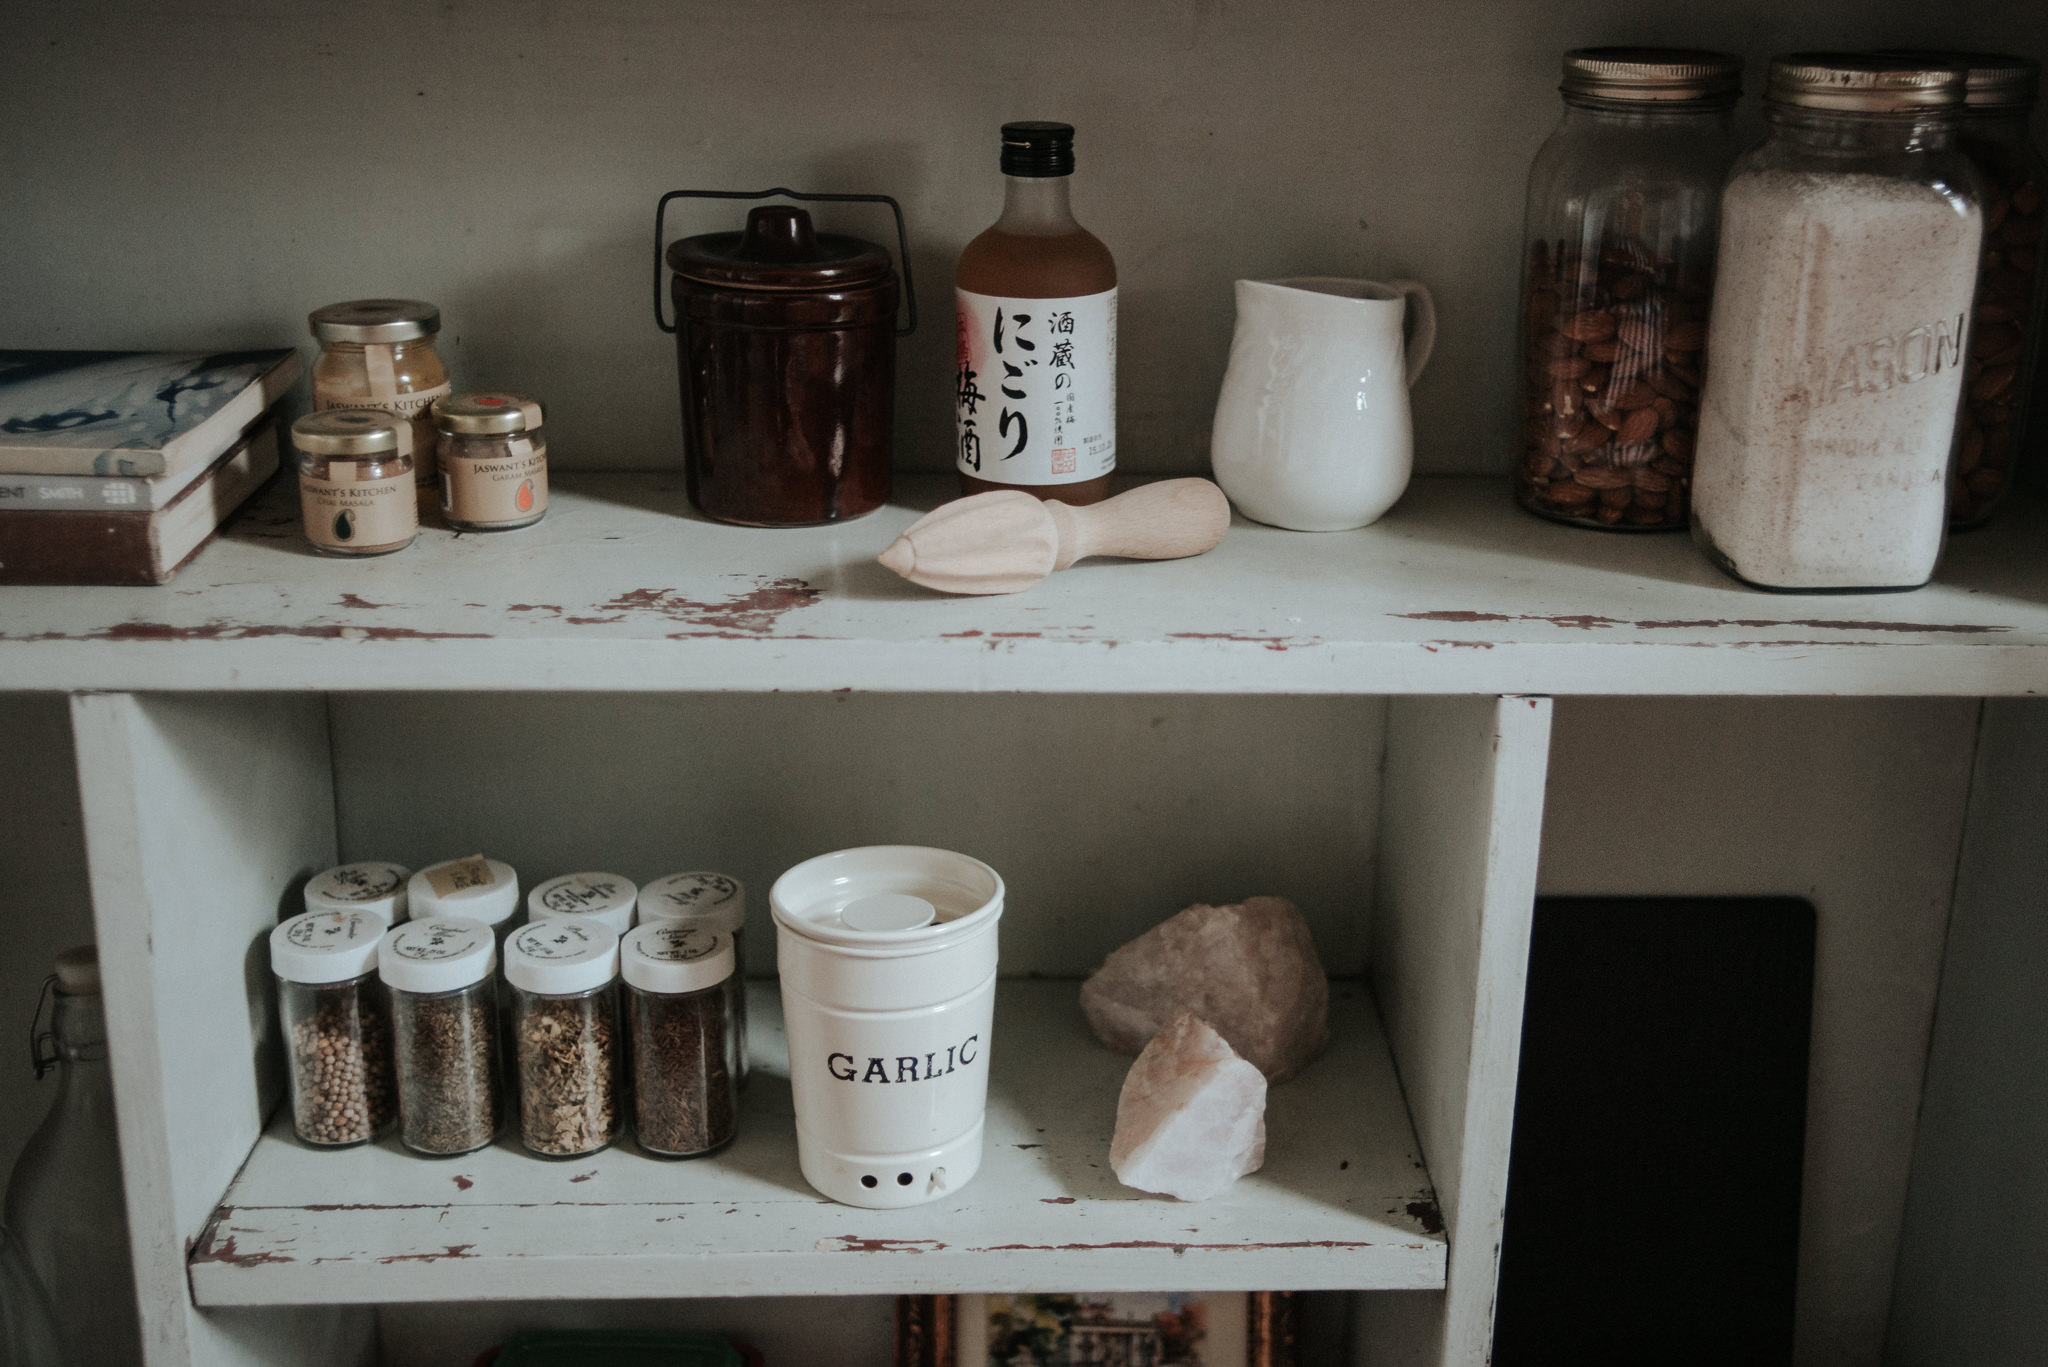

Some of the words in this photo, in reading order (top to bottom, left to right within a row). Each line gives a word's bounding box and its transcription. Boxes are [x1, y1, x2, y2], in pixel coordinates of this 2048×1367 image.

[1049, 311, 1076, 390] 酒蔵の
[994, 306, 1038, 461] にごり
[474, 459, 526, 475] JASWANT'S
[39, 487, 84, 499] SMITH
[349, 486, 397, 498] KITCHEN
[827, 1033, 979, 1084] GARLIC
